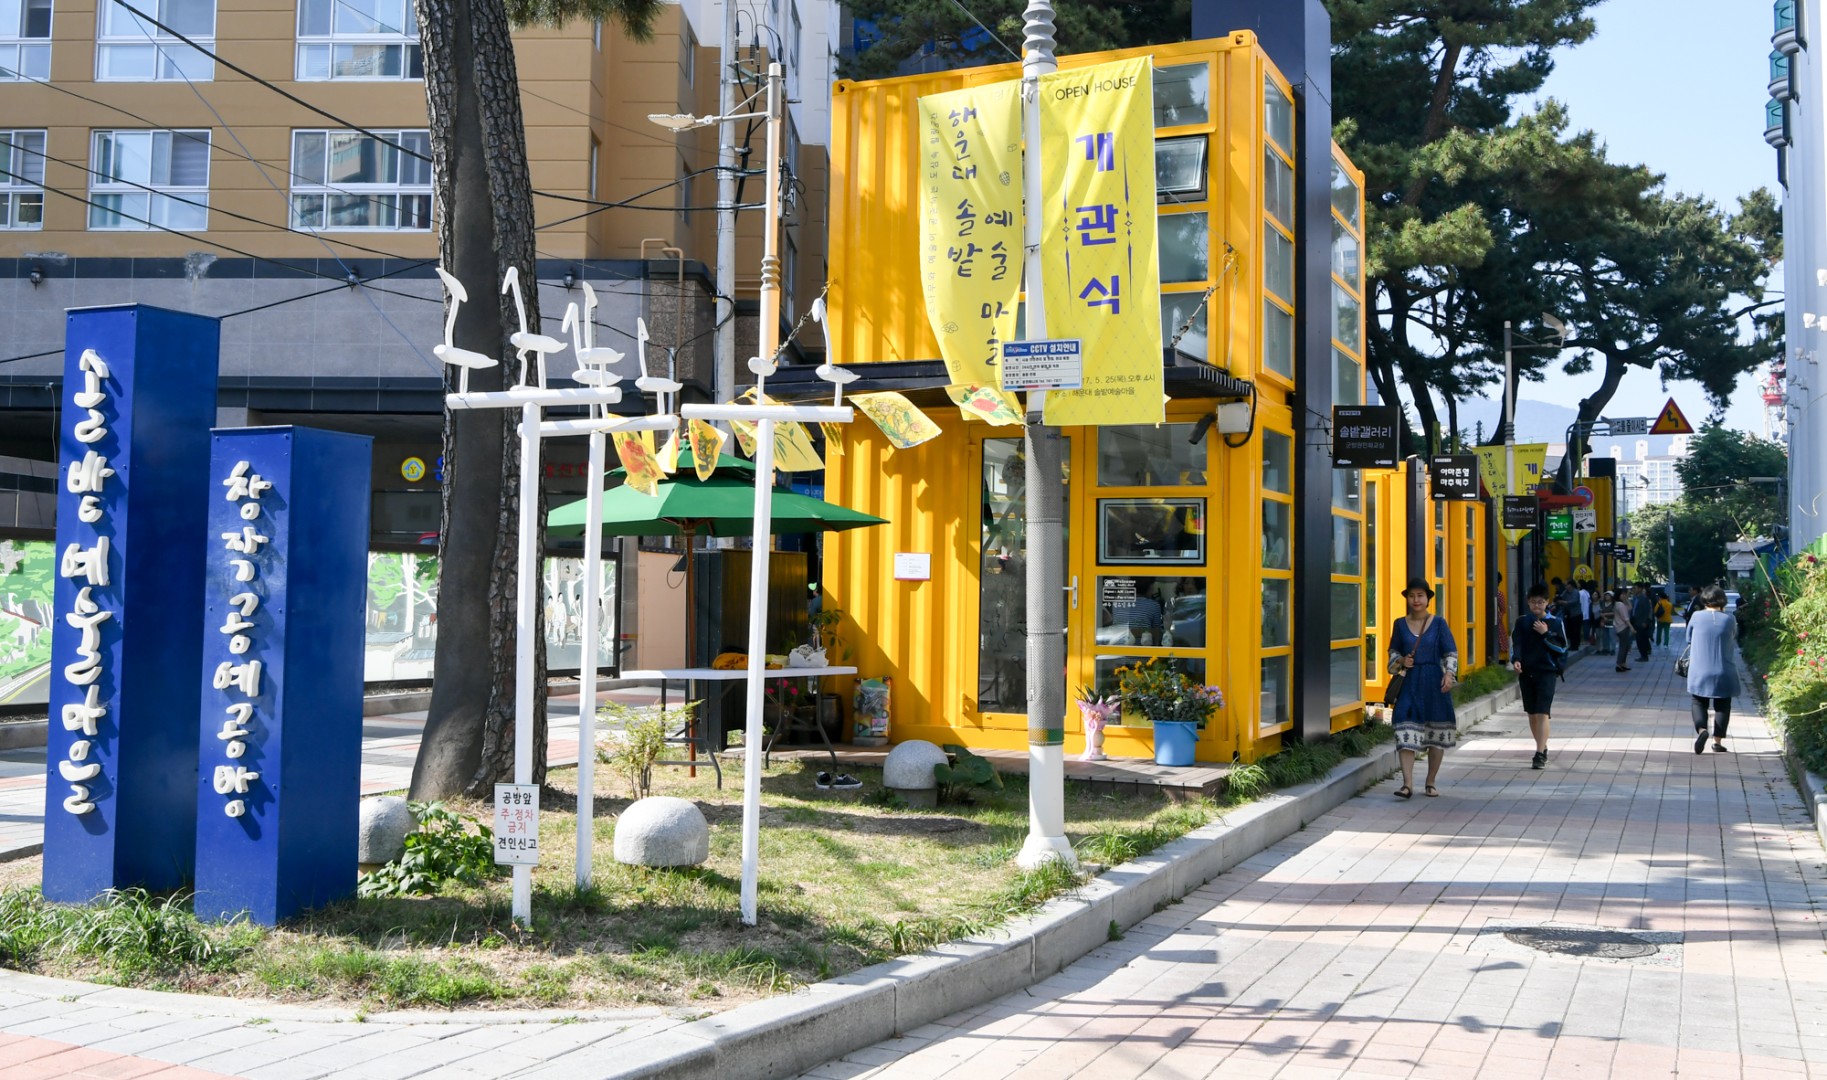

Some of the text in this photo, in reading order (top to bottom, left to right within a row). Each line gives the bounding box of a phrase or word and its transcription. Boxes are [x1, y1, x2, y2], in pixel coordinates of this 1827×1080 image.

[1055, 75, 1137, 101] OPEN HOUSE
[947, 106, 983, 278] 해운대 솔밭
[1075, 131, 1119, 316] 개관식
[1030, 344, 1048, 352] CCTV
[1049, 342, 1077, 353] 설치안내
[1340, 425, 1391, 439] 솔밭갤러리
[502, 791, 532, 805] 공방앞
[507, 821, 527, 834] 금지
[498, 837, 537, 850] 견인신고
